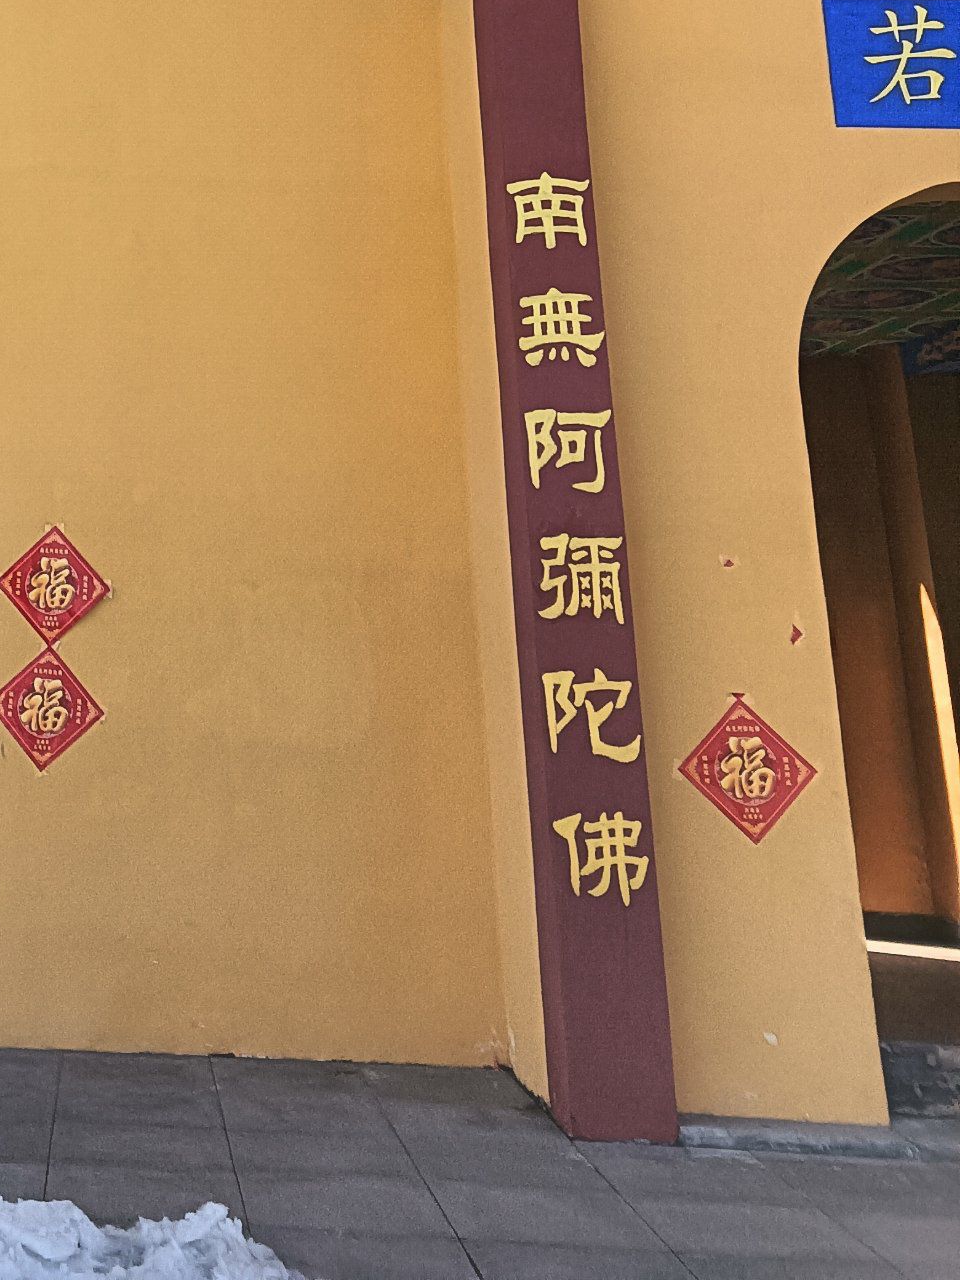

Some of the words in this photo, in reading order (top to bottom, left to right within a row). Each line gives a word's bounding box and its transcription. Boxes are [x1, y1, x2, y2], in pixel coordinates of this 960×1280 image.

[863, 4, 957, 105] 若
[506, 172, 650, 906] 南無阿彌陀佛
[28, 556, 76, 609] 福
[20, 677, 69, 732] 福
[720, 736, 776, 799] 福
